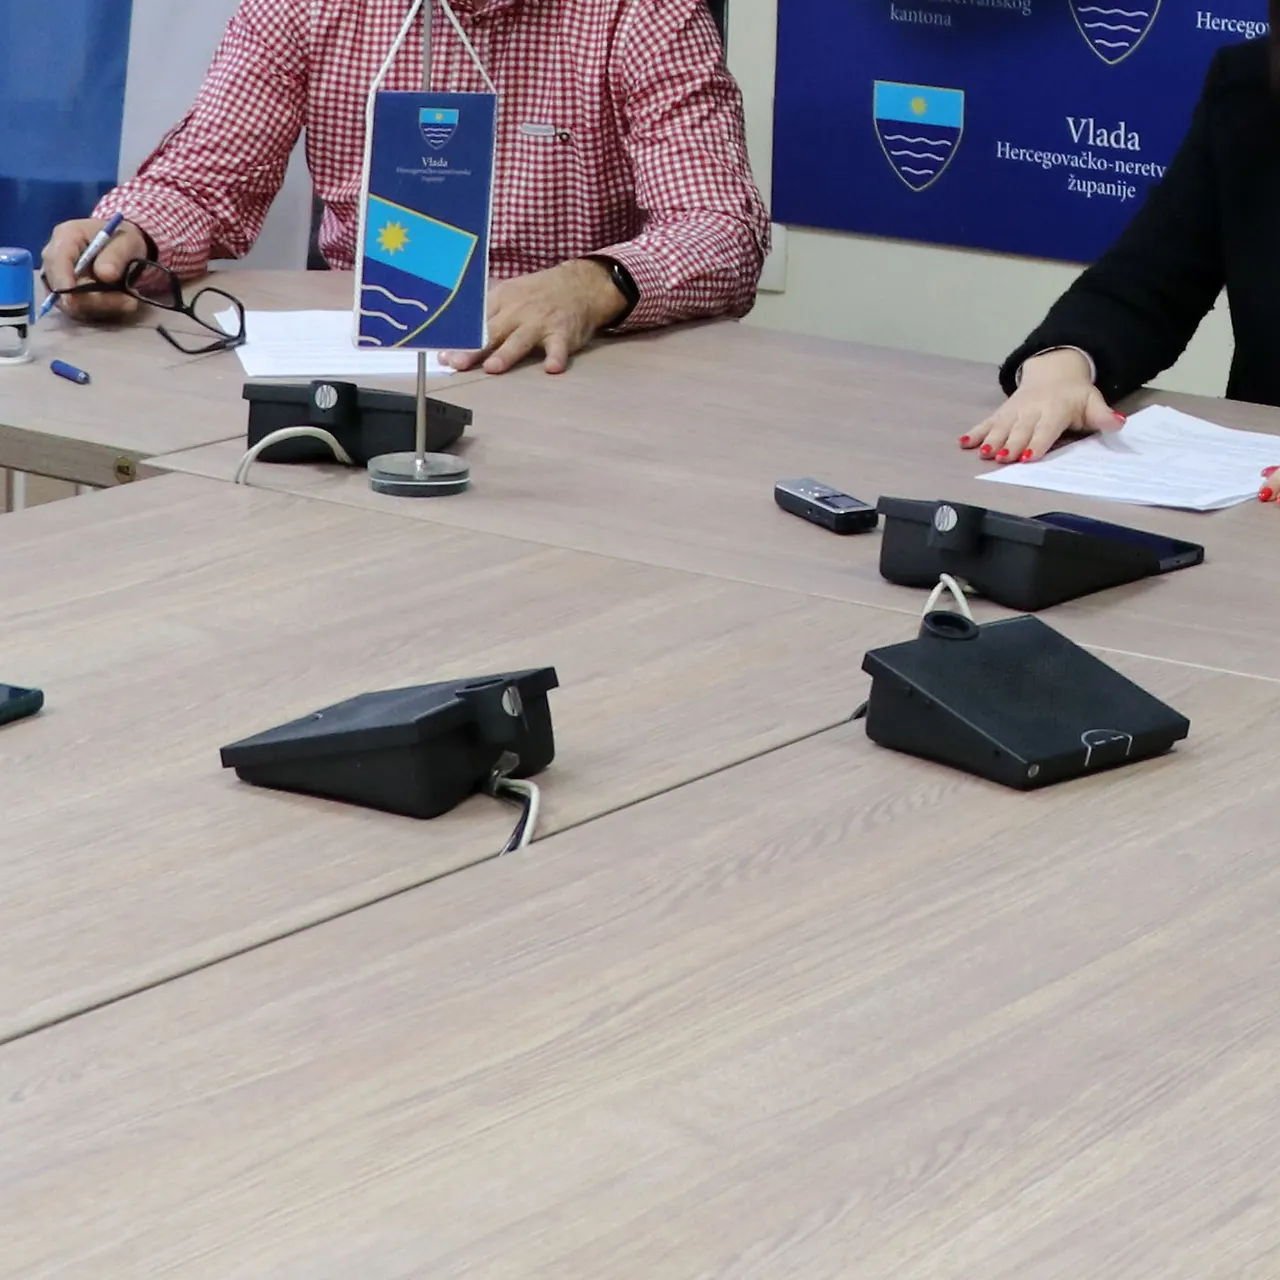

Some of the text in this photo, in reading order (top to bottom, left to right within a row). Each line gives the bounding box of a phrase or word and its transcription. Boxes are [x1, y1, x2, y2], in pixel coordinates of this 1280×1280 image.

[890, 4, 952, 27] kantona
[1066, 117, 1141, 151] Vlada
[421, 156, 449, 168] Vlada
[996, 141, 1167, 178] Hercegovačko-neretv
[1068, 174, 1136, 202] županije
